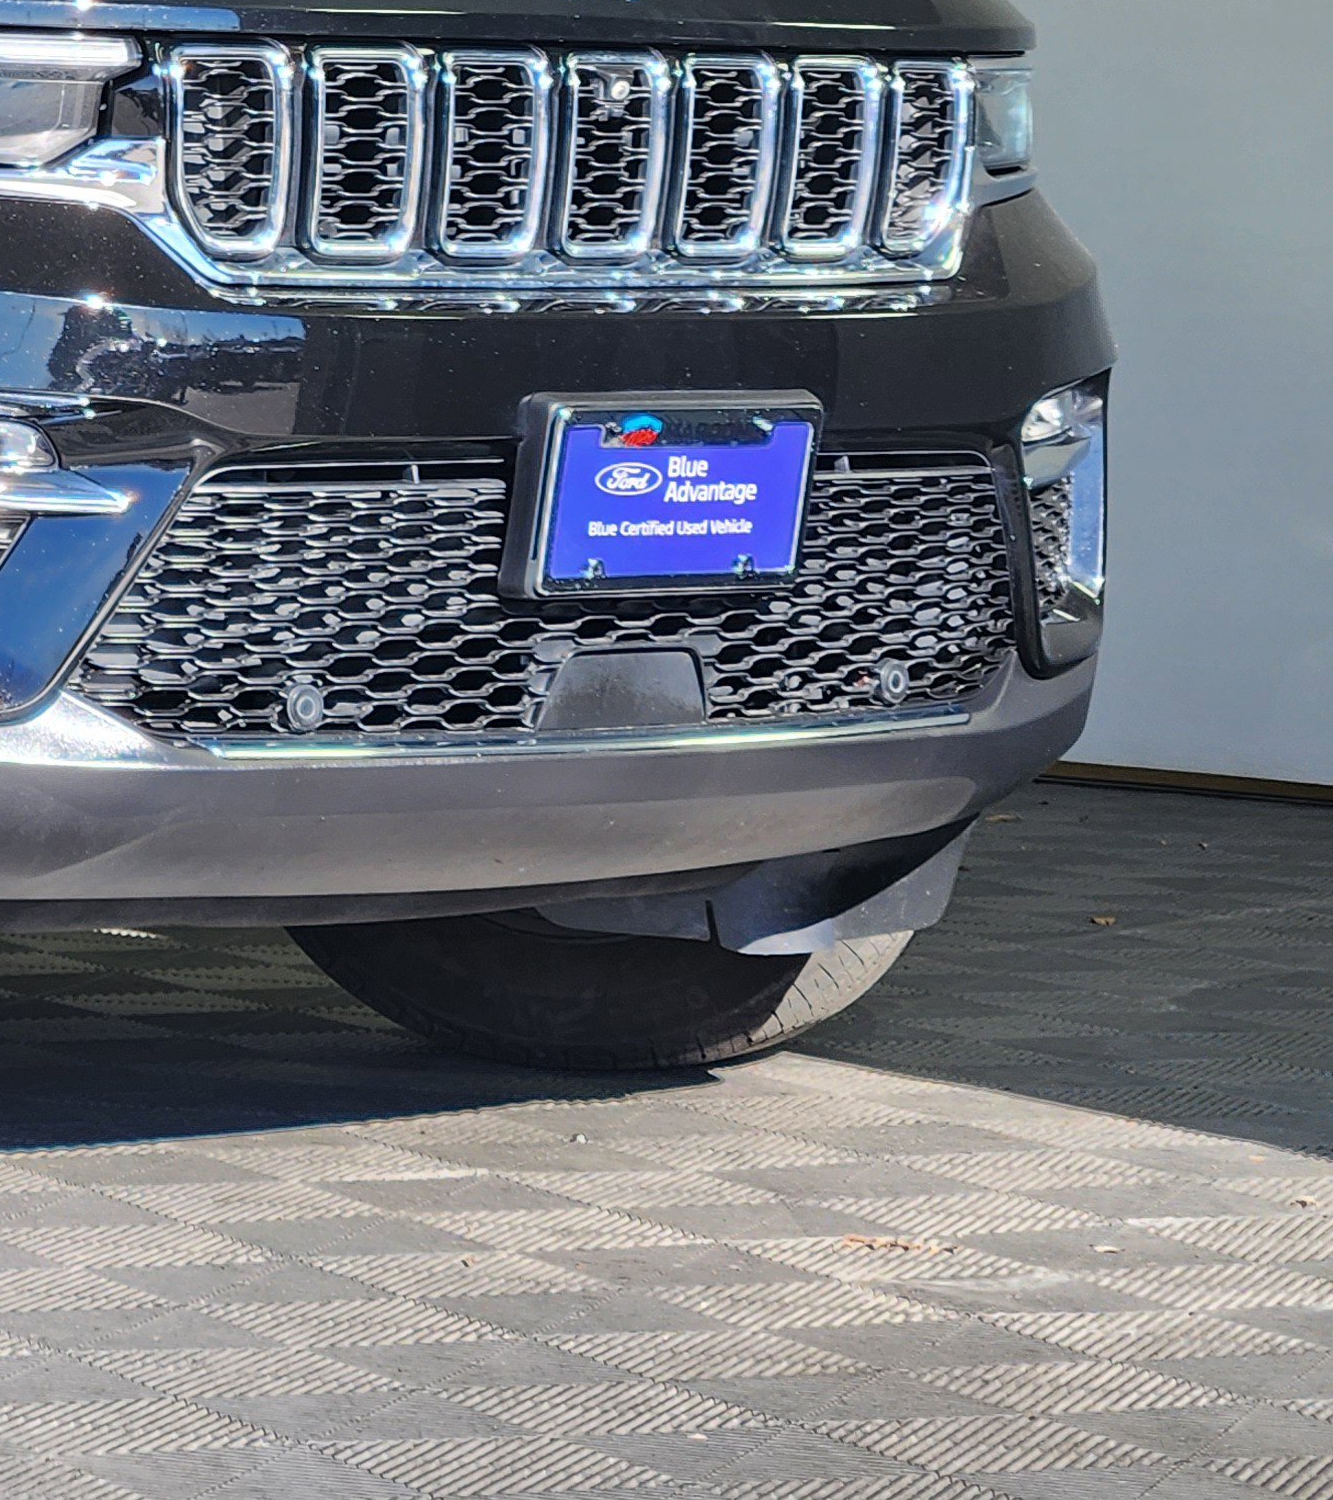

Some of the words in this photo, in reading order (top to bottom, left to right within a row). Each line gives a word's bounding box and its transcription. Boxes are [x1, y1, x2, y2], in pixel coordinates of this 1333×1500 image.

[605, 466, 652, 491] Ford
[667, 455, 709, 478] Blue
[663, 480, 759, 505] Advantage
[587, 520, 617, 537] Blue
[619, 519, 675, 537] Certified
[676, 519, 708, 536] Used
[710, 518, 754, 535] Vehicle
